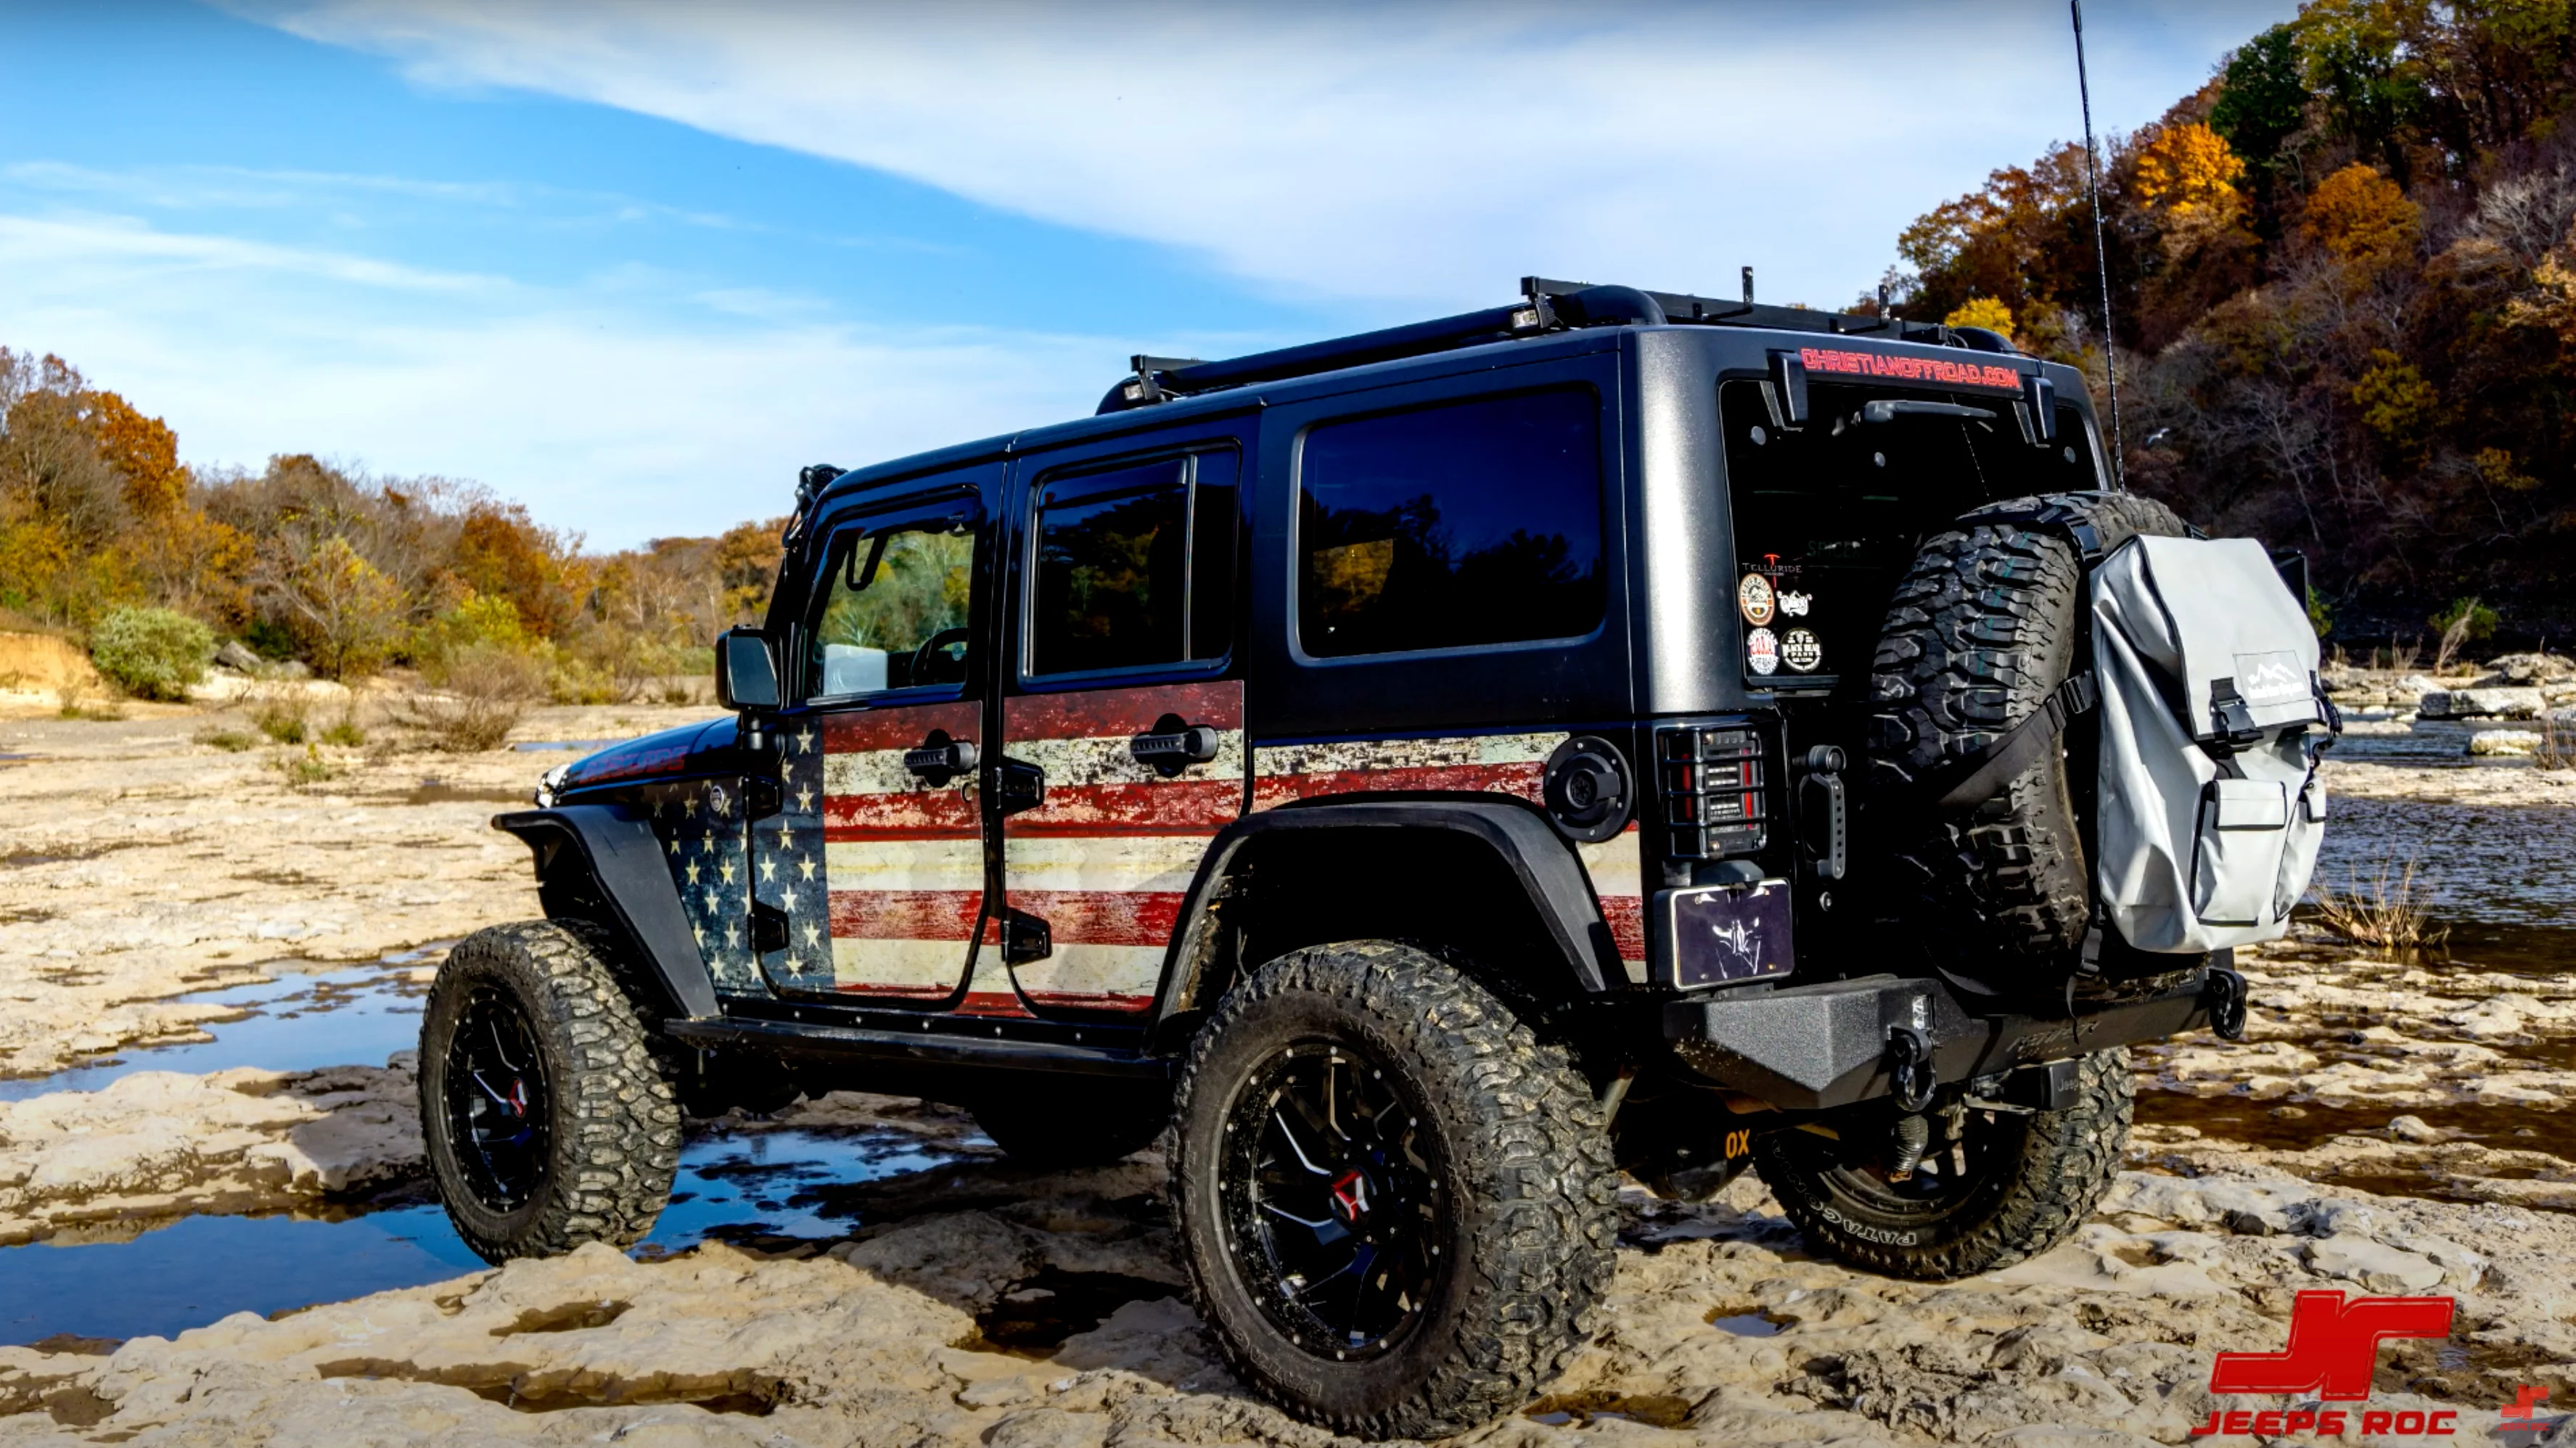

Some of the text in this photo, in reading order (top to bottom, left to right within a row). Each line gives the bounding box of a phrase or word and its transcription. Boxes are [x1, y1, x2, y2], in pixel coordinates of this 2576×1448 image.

[1801, 347, 2021, 388] CHRISTIANOFFROAD.COM
[1742, 563, 1802, 573] TELLURIDE
[1726, 1128, 1750, 1159] OX
